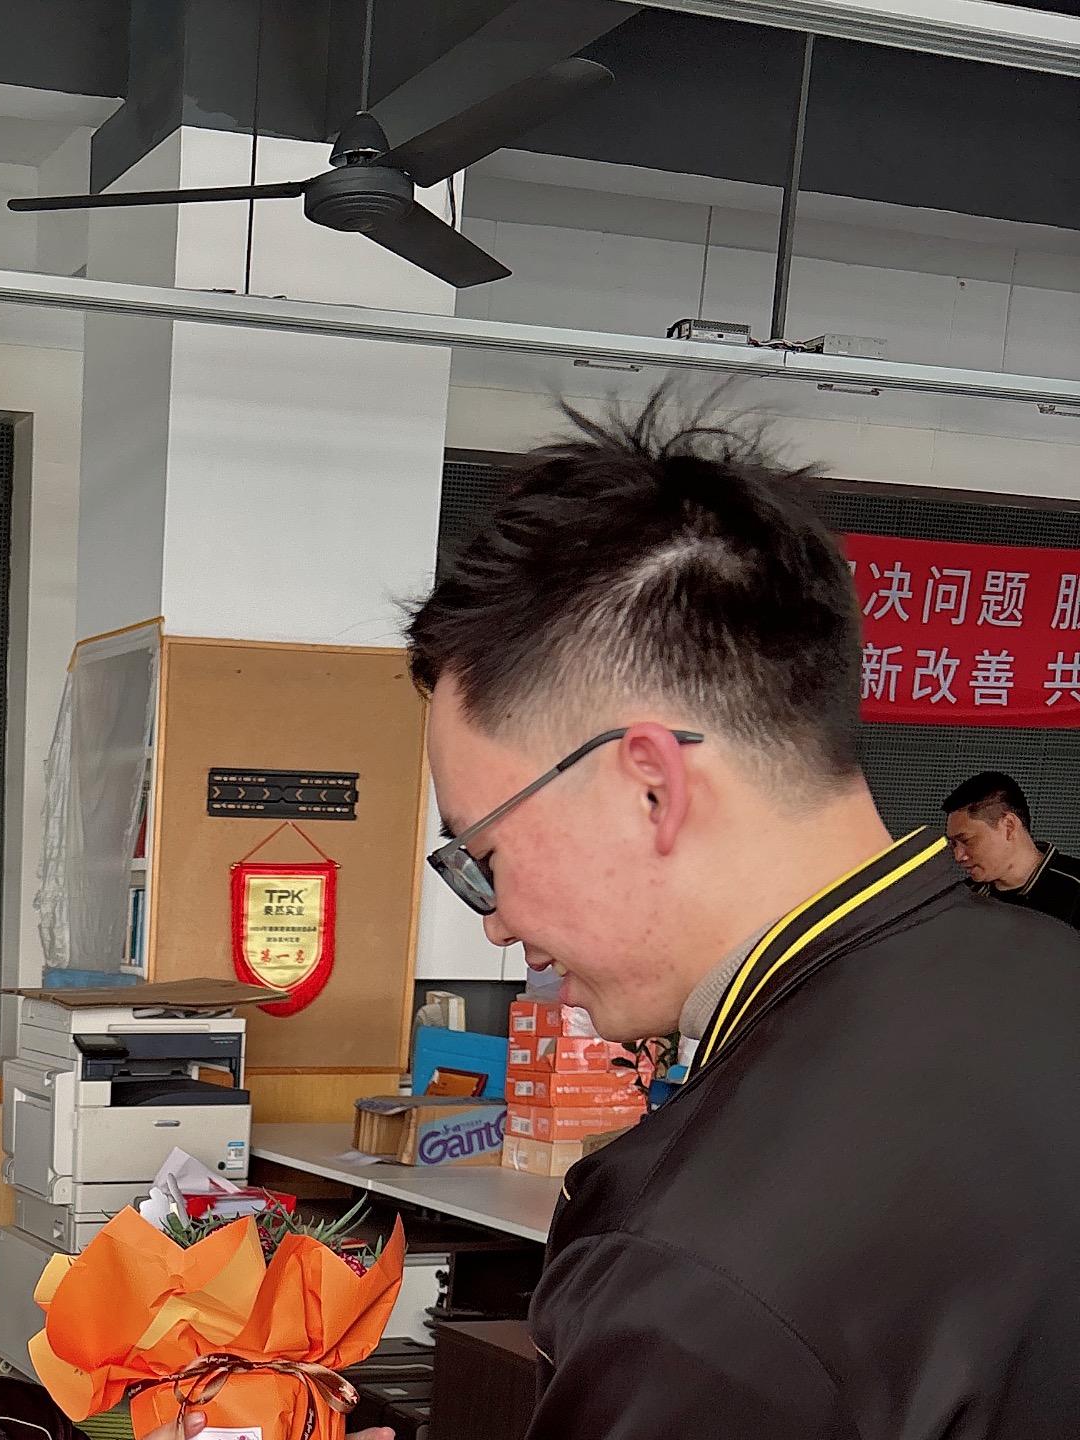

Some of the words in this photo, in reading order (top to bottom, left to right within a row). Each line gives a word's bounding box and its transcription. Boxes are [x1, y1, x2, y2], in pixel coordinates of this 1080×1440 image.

[847, 561, 1030, 627] 决问题
[861, 642, 1015, 706] 新改善
[264, 889, 305, 904] TPK
